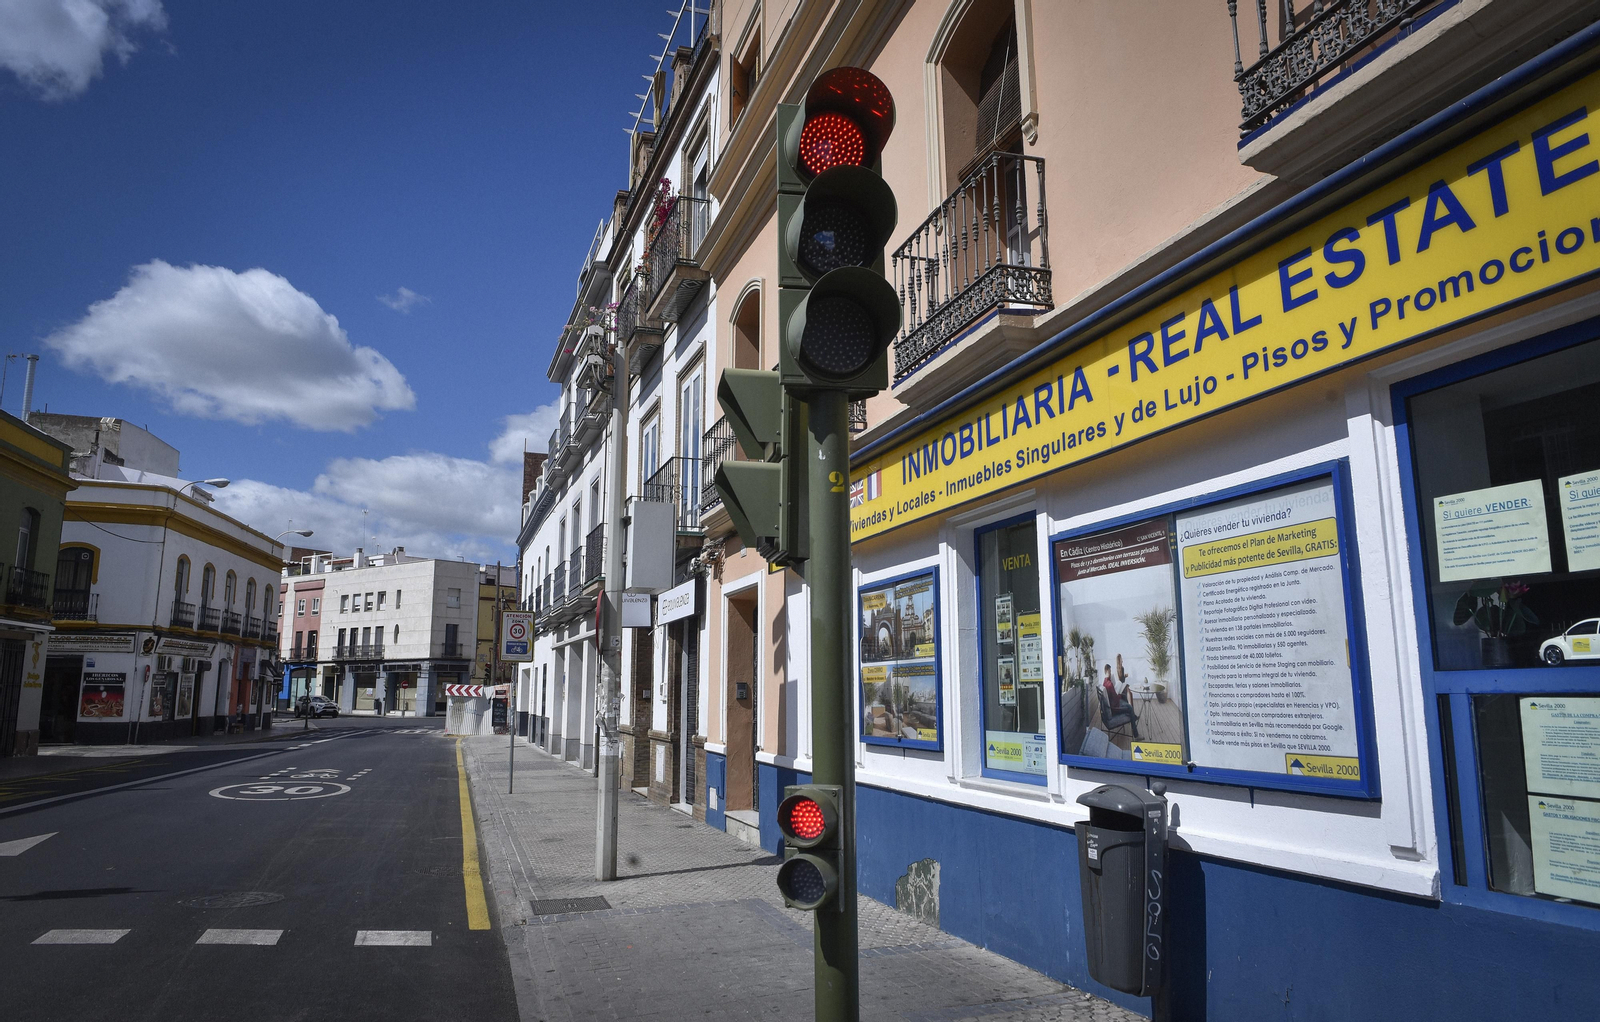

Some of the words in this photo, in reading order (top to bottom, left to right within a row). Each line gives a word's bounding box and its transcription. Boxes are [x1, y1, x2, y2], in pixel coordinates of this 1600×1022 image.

[902, 367, 1093, 485] INMOBILIARIA
[1128, 284, 1262, 383] REAL
[1278, 106, 1600, 313] ESTATE
[889, 506, 895, 522] y
[897, 489, 936, 515] Locales
[946, 459, 1012, 497] Inmuebles
[1016, 421, 1107, 469] Singulares
[1114, 413, 1125, 436] y
[1131, 400, 1157, 423] de
[1164, 375, 1217, 411] Lujo
[1242, 330, 1329, 380] Pisos
[1338, 317, 1357, 349] y
[828, 471, 845, 493] 2
[1570, 490, 1578, 499] Si
[1443, 510, 1452, 519] Si
[1454, 506, 1482, 518] quiere
[1485, 498, 1531, 512] VENDER:
[1213, 521, 1240, 533] vender
[1242, 518, 1249, 527] tu
[1251, 508, 1291, 525] vivienda?
[1060, 549, 1068, 558] En
[1069, 546, 1083, 556] Cádiz
[1199, 549, 1206, 557] Te
[1207, 544, 1240, 554] ofrecemos
[1242, 540, 1249, 549] el
[1250, 538, 1265, 547] Plan
[1266, 535, 1275, 544] de
[1277, 528, 1317, 542] Marketing
[1002, 552, 1031, 572] VENTA
[1191, 559, 1222, 571] Publicidad
[1223, 557, 1236, 566] más
[1238, 553, 1265, 566] potente
[1266, 551, 1275, 559] de
[1277, 545, 1304, 557] Sevilla,
[1305, 540, 1337, 552] GRATIS:
[996, 746, 1010, 756] Sevilla
[1010, 748, 1022, 757] 2000
[1144, 748, 1162, 758] Sevilla
[1164, 750, 1180, 759] 2000
[1306, 762, 1333, 774] Sevilla
[1336, 765, 1359, 776] 2000
[239, 786, 324, 795] 30
